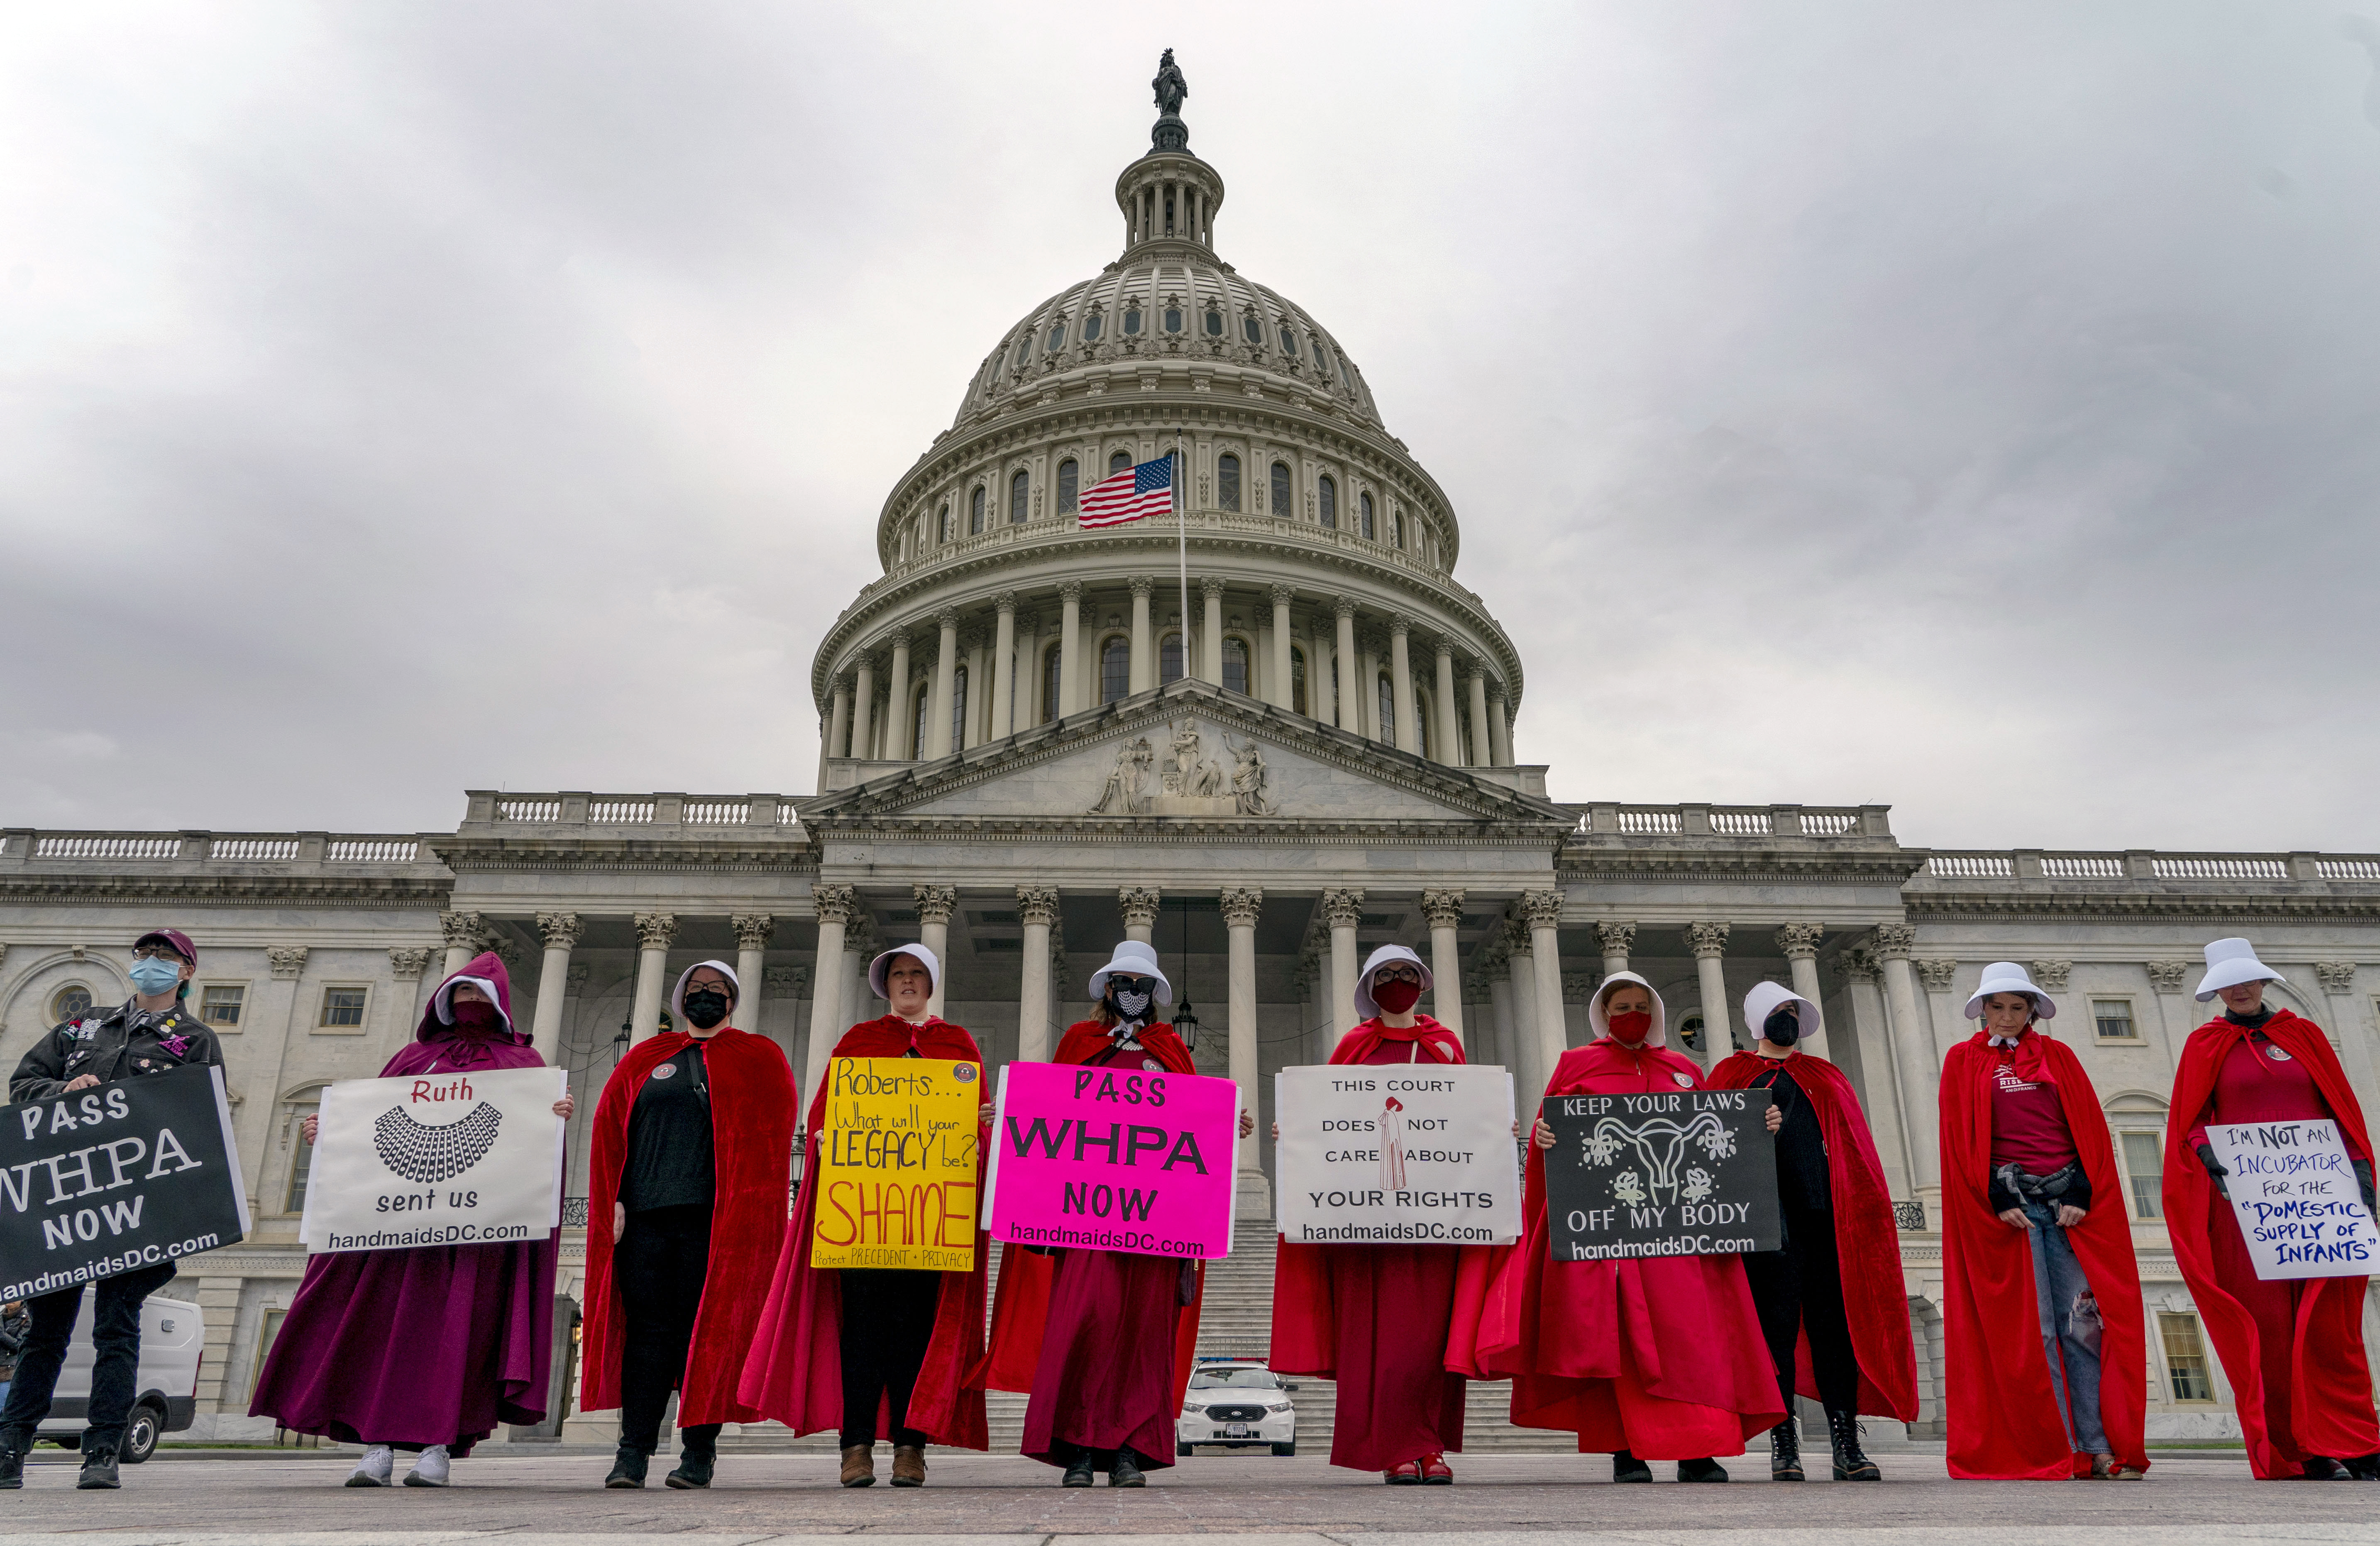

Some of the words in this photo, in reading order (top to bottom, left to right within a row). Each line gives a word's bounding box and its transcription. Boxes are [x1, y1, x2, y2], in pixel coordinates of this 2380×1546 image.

[834, 1058, 961, 1097] Roberts...
[1074, 1070, 1166, 1107] PASS
[1332, 1080, 1376, 1091] THIS
[1387, 1080, 1455, 1092] COURT
[411, 1078, 473, 1103] Ruth
[21, 1088, 130, 1140] PASS
[835, 1101, 883, 1130] What
[892, 1103, 919, 1129] will
[928, 1120, 960, 1133] your
[1564, 1098, 1612, 1116] KEEP
[1623, 1095, 1681, 1113] YOUR
[1693, 1093, 1745, 1111] LAWS
[1322, 1120, 1375, 1132] DOES
[1408, 1119, 1448, 1130] NOT
[2227, 1128, 2253, 1146] I'M
[2258, 1125, 2300, 1149] NOT
[2307, 1125, 2331, 1143] AN
[831, 1130, 936, 1170] LEGACY
[942, 1134, 977, 1168] be?
[1005, 1116, 1209, 1175] WHPA
[1325, 1150, 1379, 1162] CARE
[1405, 1150, 1473, 1164] ABOUT
[2233, 1153, 2352, 1178] INCUBATOR
[376, 1189, 435, 1212] sent
[450, 1191, 477, 1208] us
[1308, 1191, 1384, 1208] YOUR
[1396, 1191, 1493, 1208] RIGHTS
[2263, 1180, 2295, 1196] FOR
[2299, 1181, 2333, 1195] THE
[1063, 1182, 1158, 1221] NOW
[2241, 1201, 2366, 1226] "DOMESTIC
[43, 1194, 144, 1250] NOW
[816, 1181, 976, 1248] SHAME
[1568, 1209, 1614, 1232] OFF
[1630, 1207, 1666, 1229] MY
[1681, 1202, 1750, 1226] BODY
[329, 1224, 528, 1249] handmaidsDC.com
[1010, 1222, 1204, 1255] handmaidsDC.com
[1303, 1223, 1493, 1241] handmaidsDC.com
[2253, 1222, 2325, 1242] SUPPLY
[2336, 1222, 2359, 1236] OF
[815, 1251, 846, 1265] Protect
[851, 1248, 910, 1265] PRECEDENT
[922, 1250, 970, 1268] PRIVACY
[1571, 1235, 1754, 1260] handmaidsDC.com
[2275, 1238, 2377, 1265] INFANTS"
[0, 1232, 218, 1302] andmaidsDC.com
